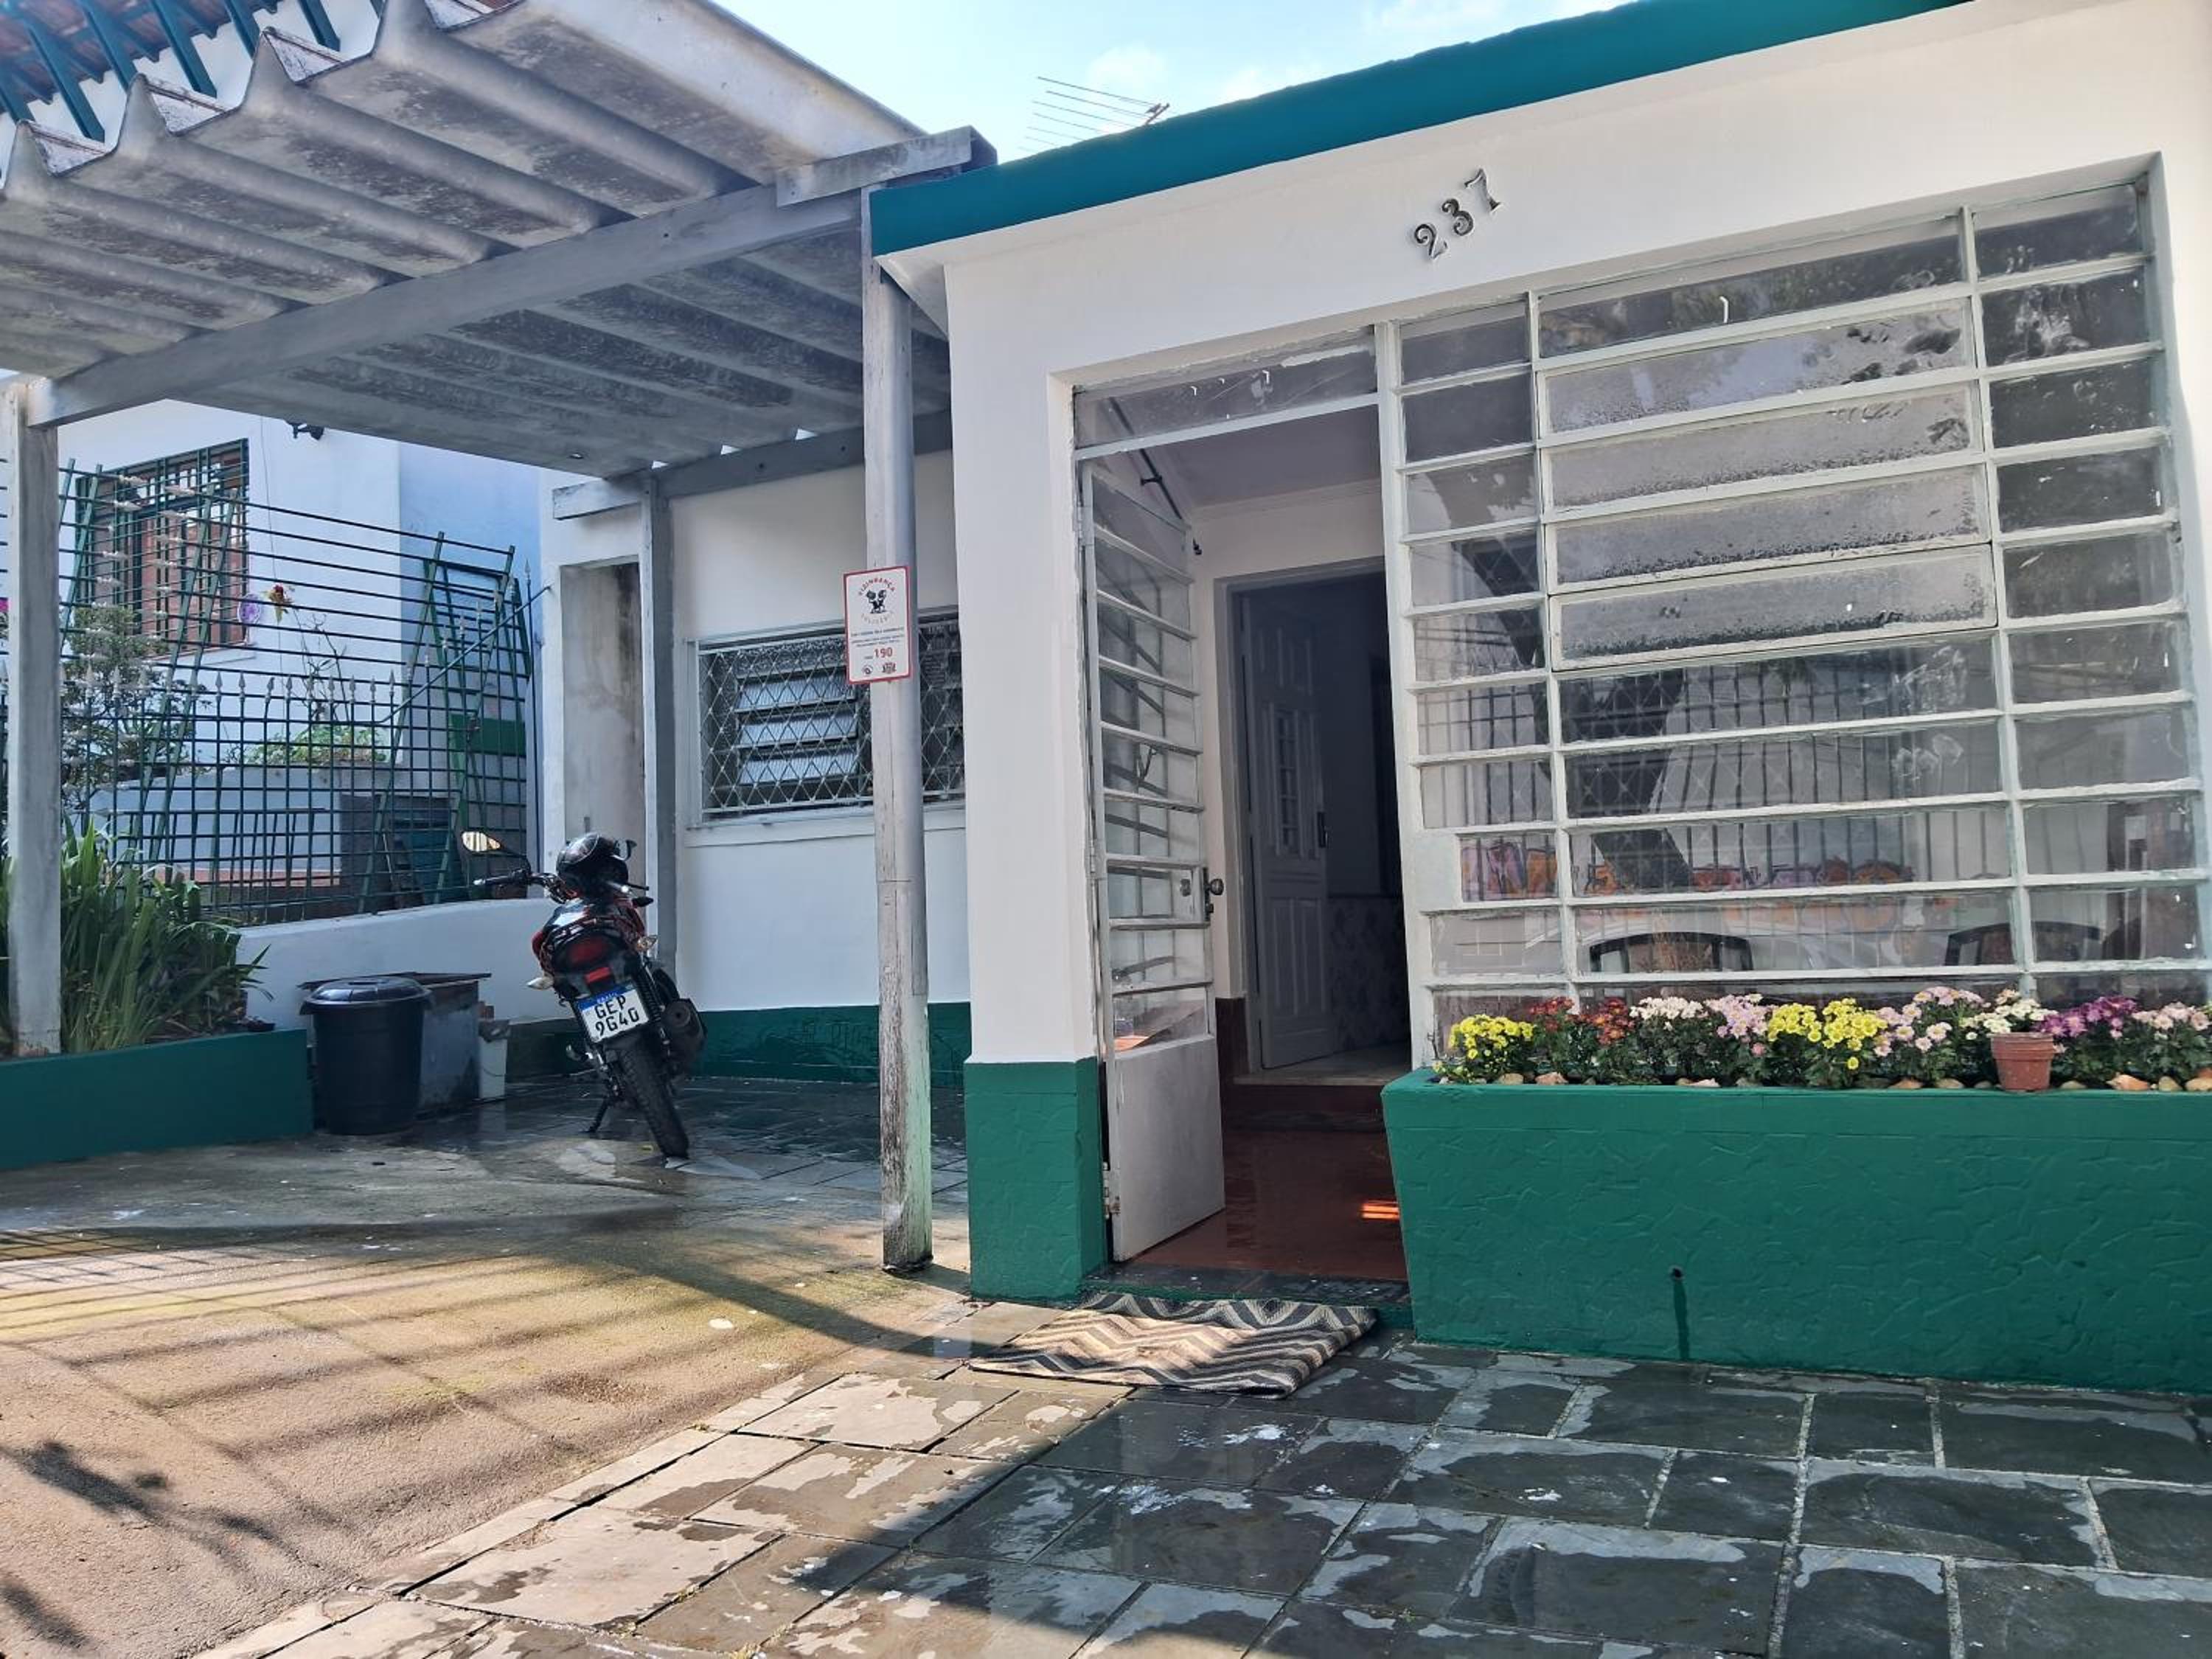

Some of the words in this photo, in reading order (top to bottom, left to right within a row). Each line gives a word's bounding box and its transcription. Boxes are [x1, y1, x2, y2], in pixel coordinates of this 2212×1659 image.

[1414, 168, 1501, 259] 237
[874, 647, 893, 658] 190
[594, 995, 626, 1019] GEP
[595, 1007, 639, 1036] 9G40
